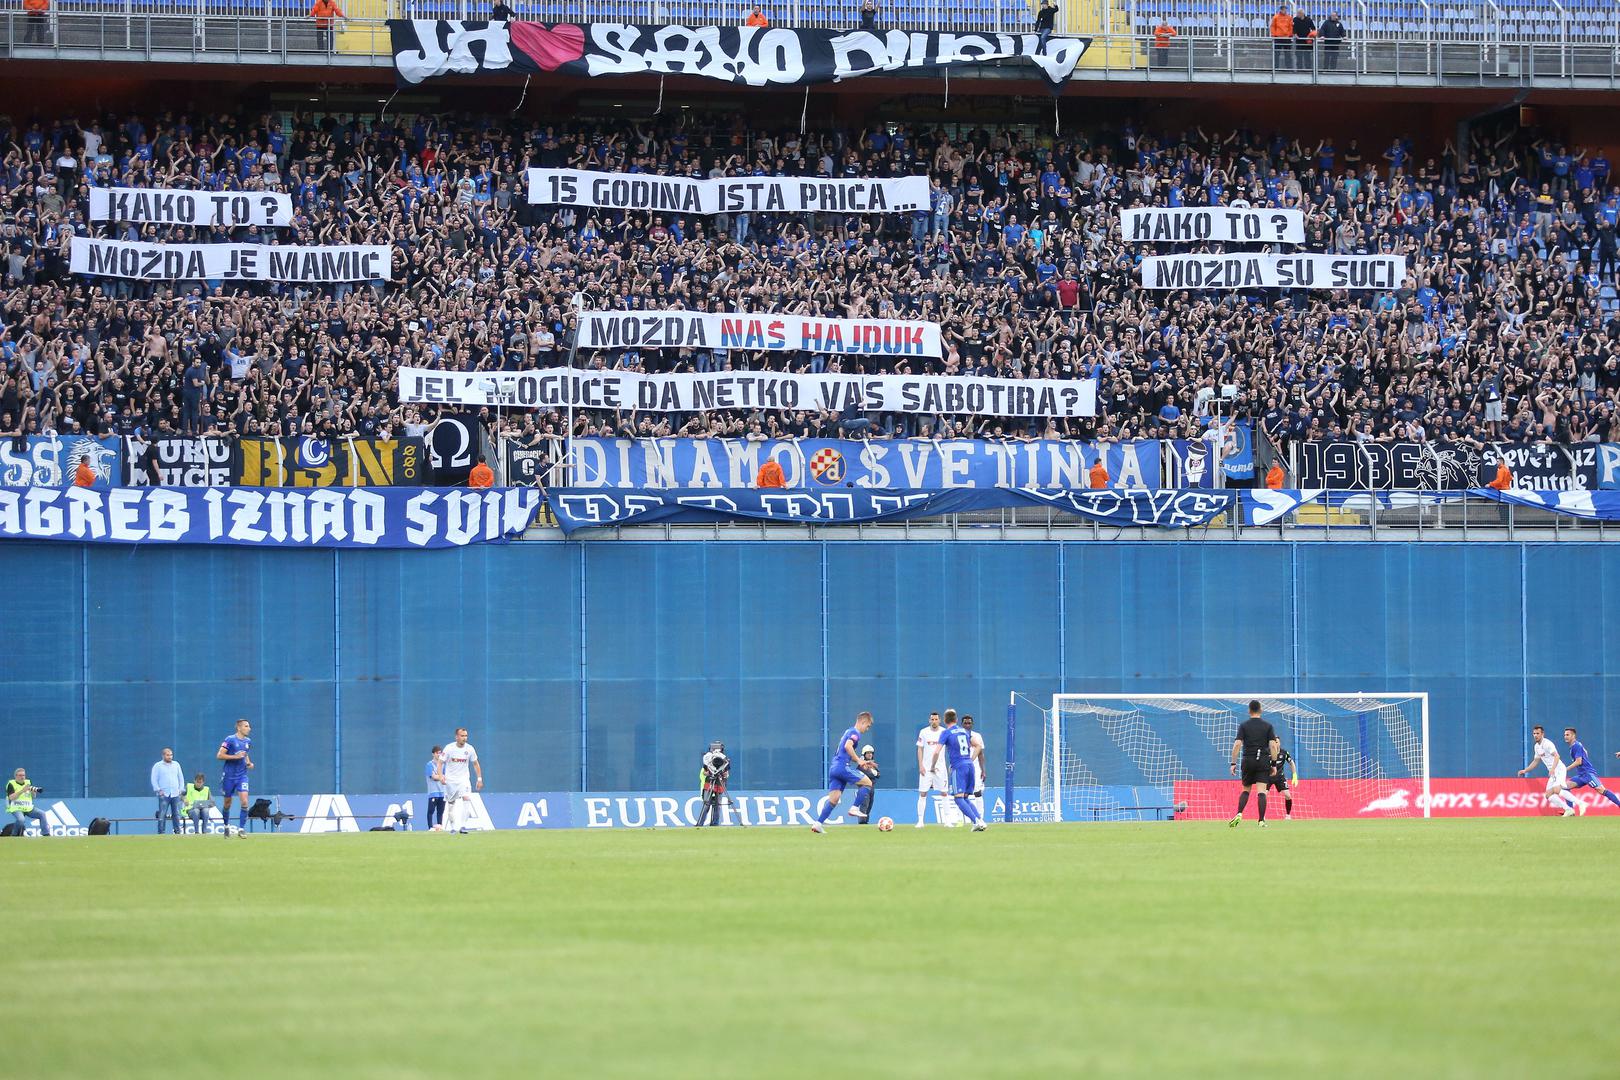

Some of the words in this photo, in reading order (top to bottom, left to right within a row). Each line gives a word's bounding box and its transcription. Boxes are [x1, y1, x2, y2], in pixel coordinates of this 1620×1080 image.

[108, 192, 195, 223] KAKO
[211, 196, 250, 225] TO
[548, 175, 577, 203] 15
[592, 178, 701, 211] GODINA
[718, 183, 785, 211] ISTA
[1133, 212, 1212, 240] KAKO
[1225, 213, 1262, 240] TO
[88, 243, 207, 279] MOŽDA
[223, 249, 258, 278] JE
[1155, 258, 1264, 287] MOŽDA
[1276, 258, 1314, 287] SU
[1331, 260, 1395, 288] SUCI
[590, 316, 707, 346] MOŽDA
[721, 318, 786, 349] NAŠ
[801, 322, 924, 354] HAJDUK
[638, 380, 681, 409] DA
[692, 377, 799, 409] NETKO
[820, 381, 884, 410] VAS
[902, 382, 1079, 416] SABOTIRA?
[573, 439, 801, 488] DINAMO
[1301, 442, 1424, 490] 1986
[203, 488, 386, 544] IZNAD
[957, 734, 969, 756] 8
[516, 798, 549, 827] A1
